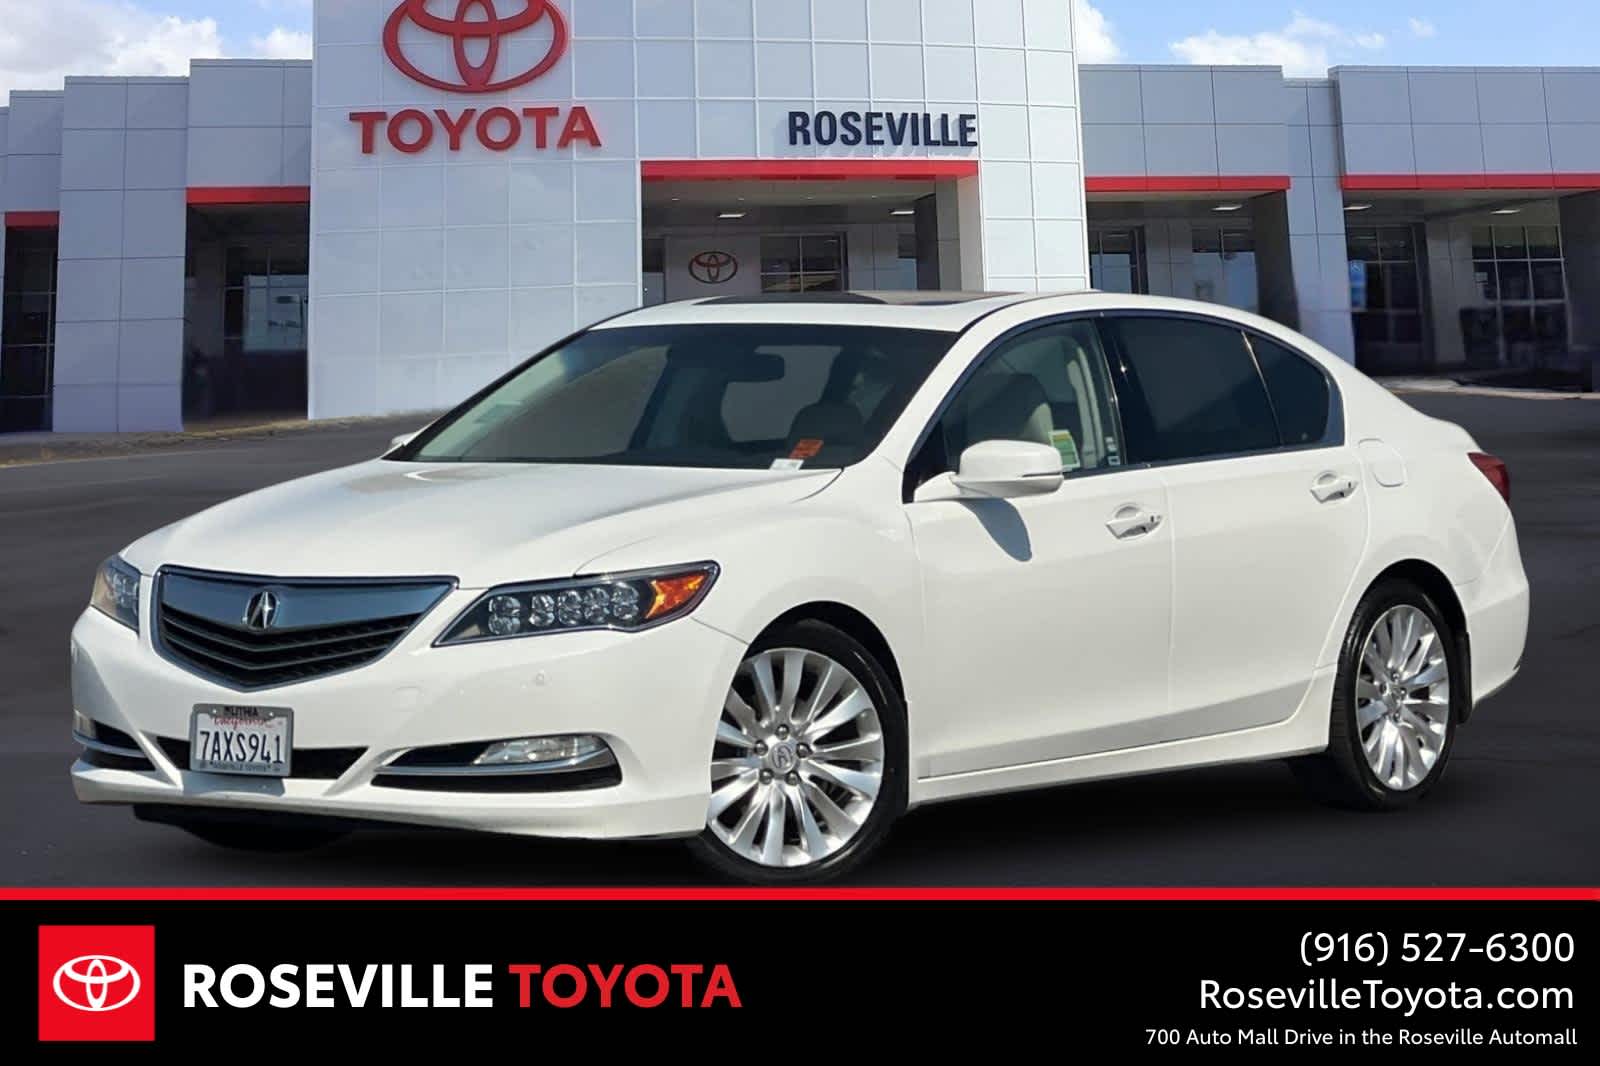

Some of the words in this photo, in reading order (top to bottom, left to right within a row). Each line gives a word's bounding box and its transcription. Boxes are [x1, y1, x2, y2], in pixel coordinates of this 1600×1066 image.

[349, 106, 602, 154] TOYOTA
[788, 110, 978, 147] ROSEVILLE
[199, 730, 284, 764] 7AXS941
